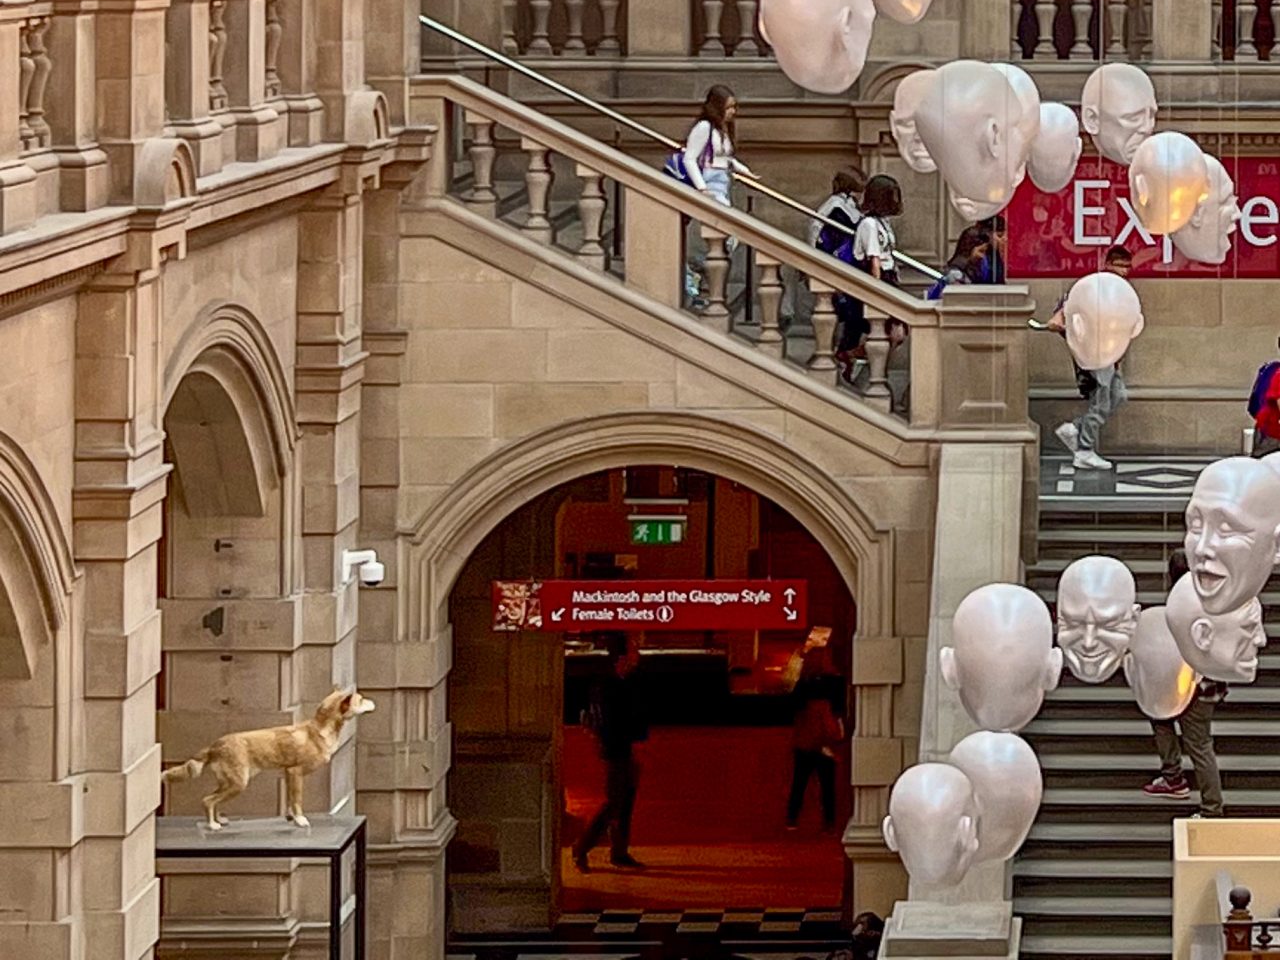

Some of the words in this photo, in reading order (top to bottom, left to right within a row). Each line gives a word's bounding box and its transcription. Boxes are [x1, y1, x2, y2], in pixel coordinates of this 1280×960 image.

[572, 590, 639, 603] Mackintosh
[642, 590, 665, 603] and
[667, 590, 688, 603] the
[689, 590, 739, 605] Glasgow
[741, 589, 771, 605] Style
[572, 607, 614, 621] Female
[616, 606, 655, 621] Toilets
